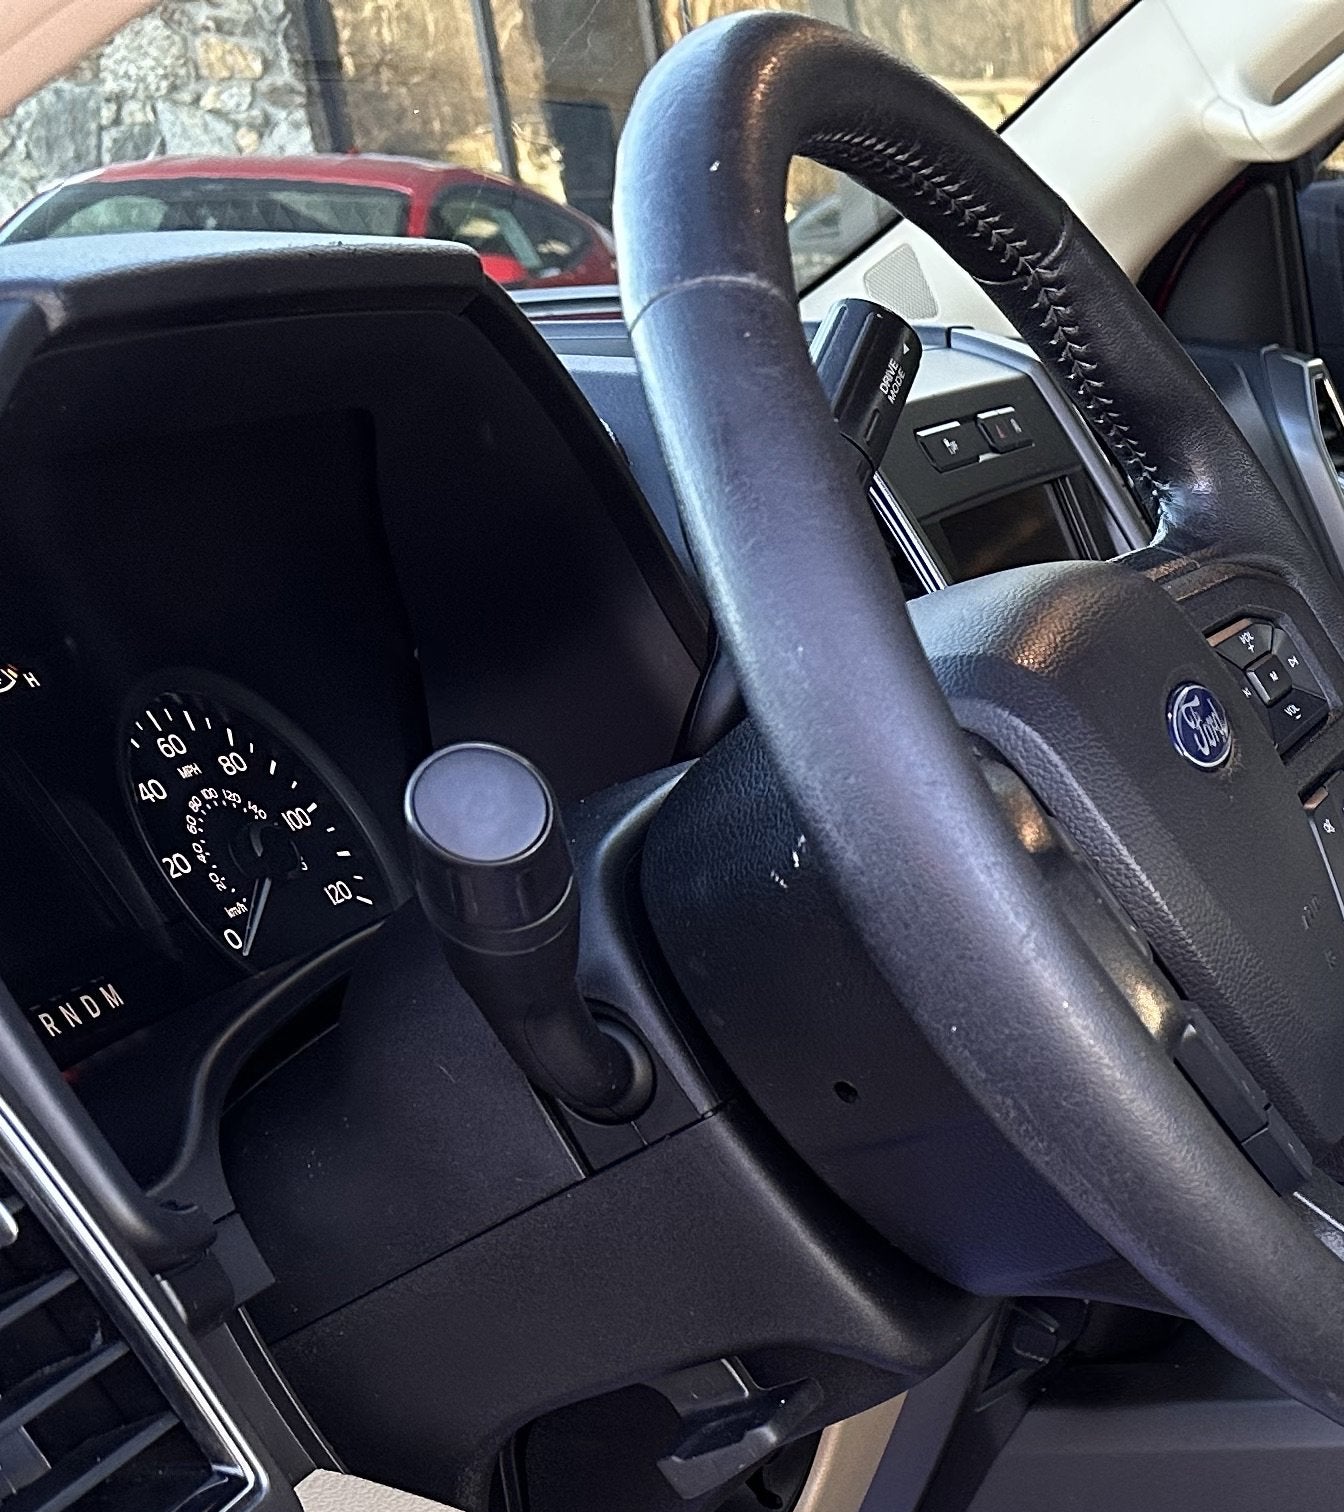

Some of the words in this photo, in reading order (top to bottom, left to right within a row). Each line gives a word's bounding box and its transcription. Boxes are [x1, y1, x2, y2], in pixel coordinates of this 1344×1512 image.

[879, 357, 899, 395] DRIVE
[887, 366, 906, 404] MODE
[1239, 631, 1254, 644] VOL
[22, 671, 41, 688] H
[1284, 704, 1300, 716] VOL
[1181, 694, 1228, 756] Ford
[156, 733, 188, 759] 60
[176, 762, 203, 779] MPH
[217, 751, 248, 776] 80
[138, 778, 168, 803] 40
[200, 787, 219, 801] 100
[221, 788, 242, 805] 120
[188, 795, 202, 813] 80
[247, 800, 268, 820] 140
[185, 814, 198, 835] 60
[280, 807, 312, 832] 100
[191, 842, 207, 864] 40
[161, 852, 193, 879] 20
[208, 872, 228, 892] 20
[323, 880, 353, 906] 120
[224, 901, 249, 919] km/h
[223, 928, 244, 950] 0
